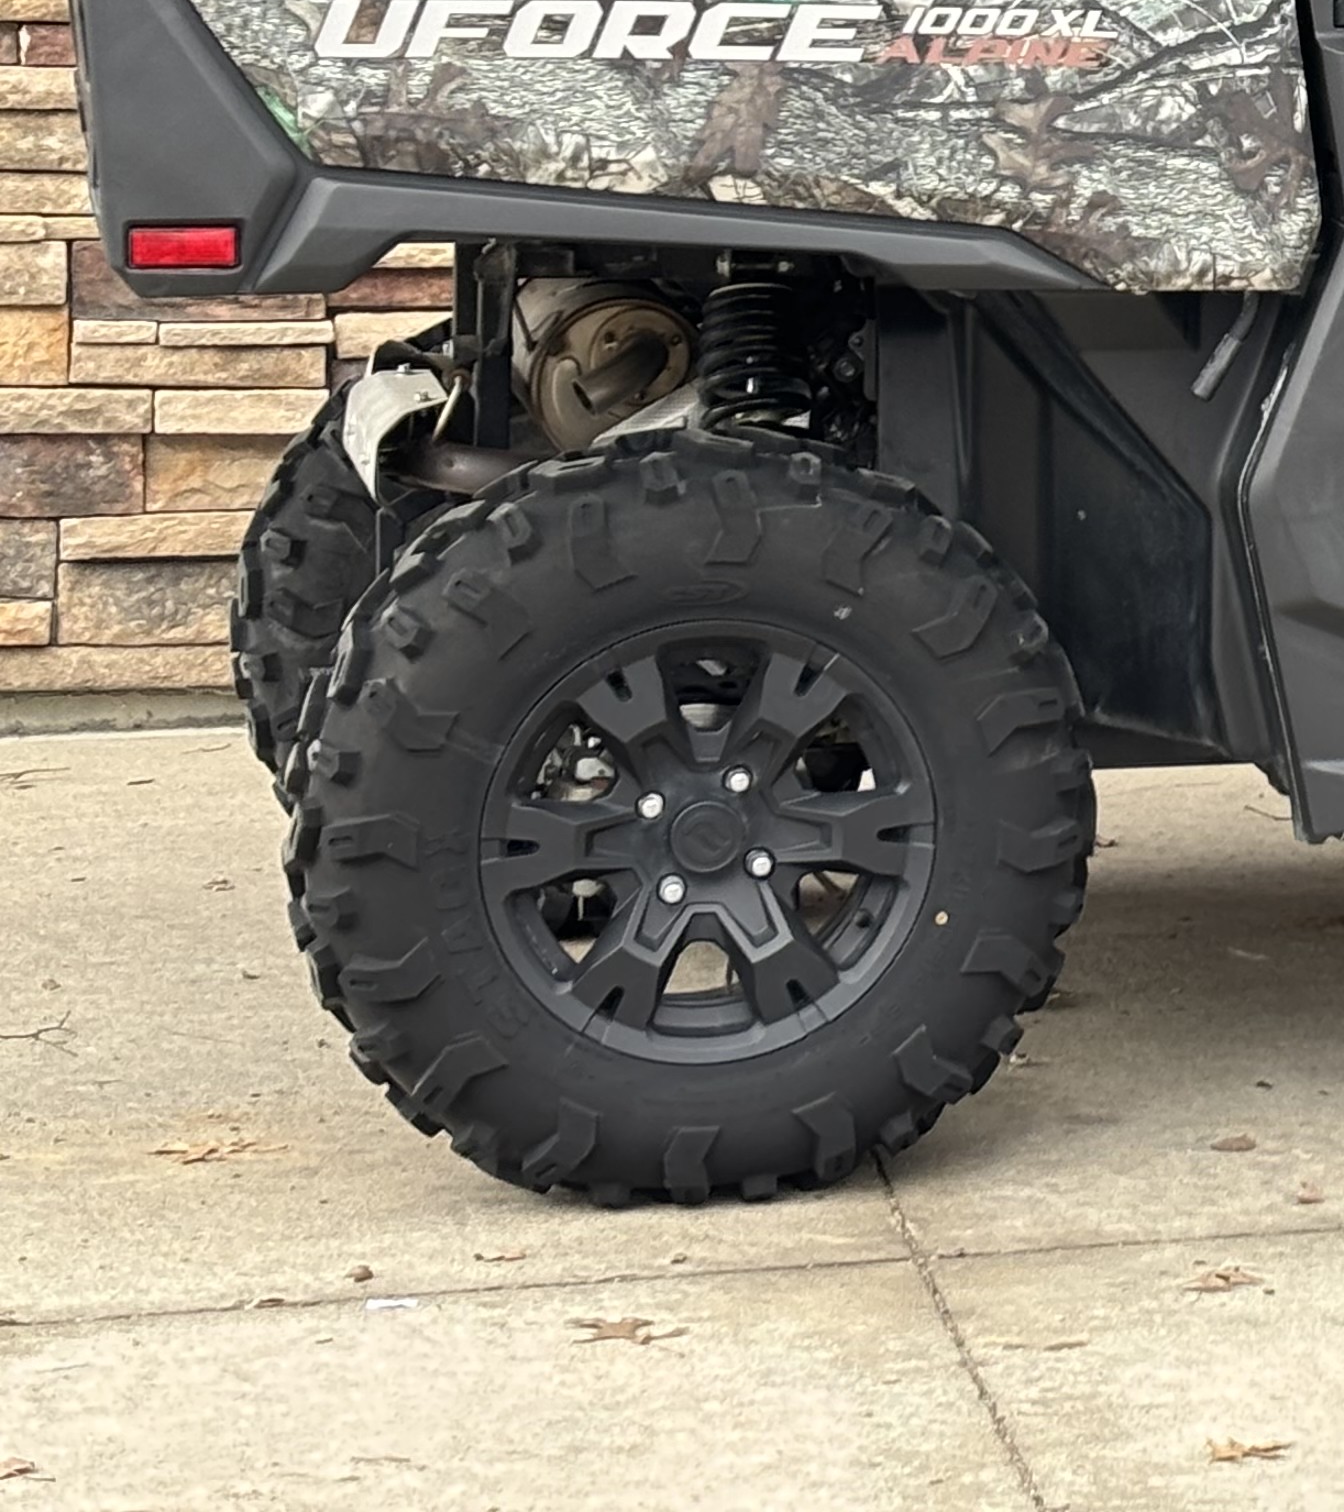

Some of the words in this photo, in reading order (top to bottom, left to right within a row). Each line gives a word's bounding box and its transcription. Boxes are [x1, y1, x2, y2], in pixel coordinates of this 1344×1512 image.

[903, 6, 1040, 36] 1000
[1043, 9, 1119, 39] XL
[874, 35, 1112, 68] ALPINE
